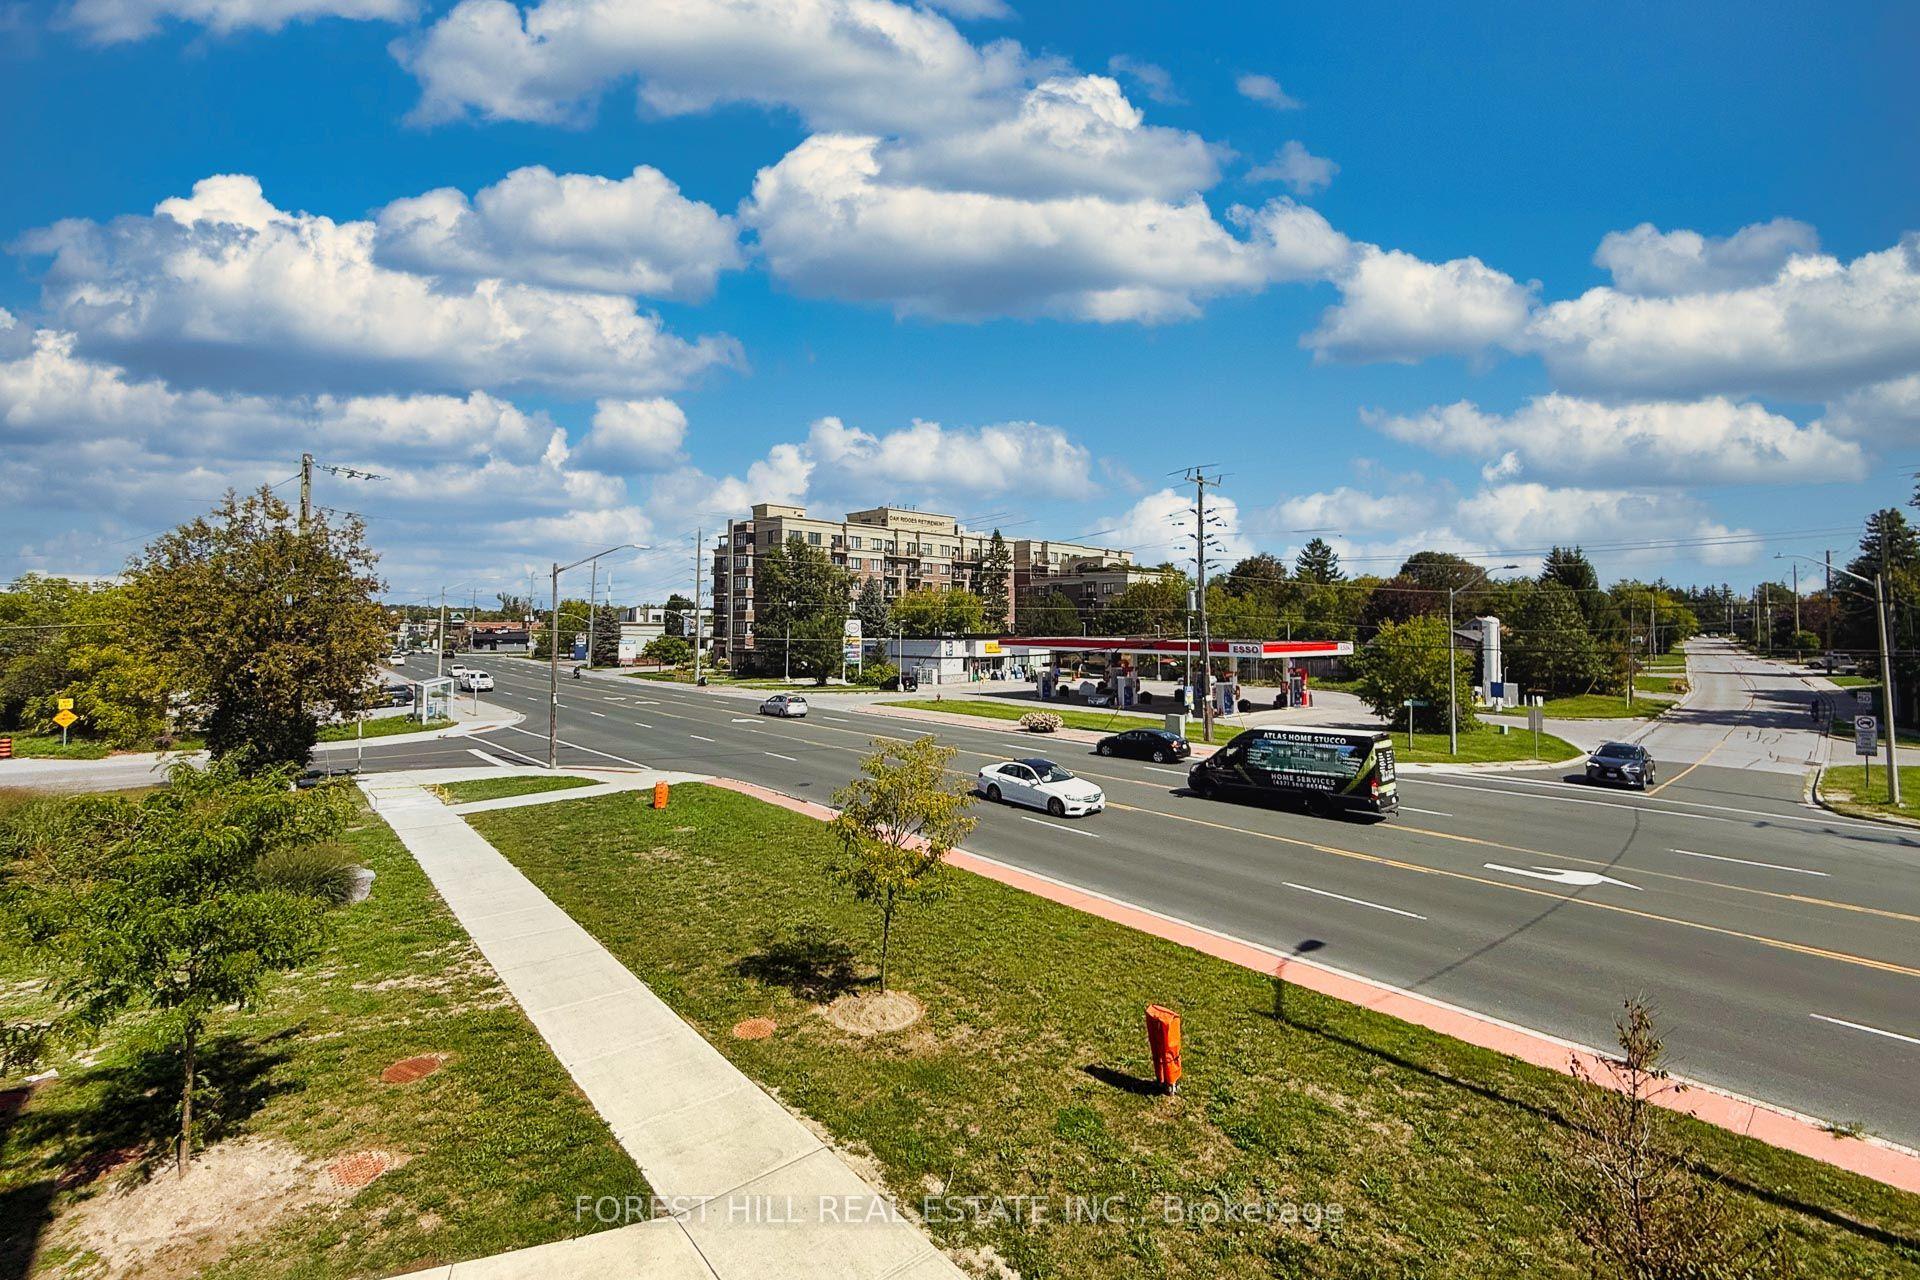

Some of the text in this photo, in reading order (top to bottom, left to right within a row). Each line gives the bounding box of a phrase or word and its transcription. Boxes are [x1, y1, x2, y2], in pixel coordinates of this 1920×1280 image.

[918, 518, 945, 527] RETIREMENT
[1233, 645, 1259, 654] ESSO
[1263, 732, 1347, 744] ATLAS HOME STUCCO
[1271, 773, 1336, 785] HOME SERVICES
